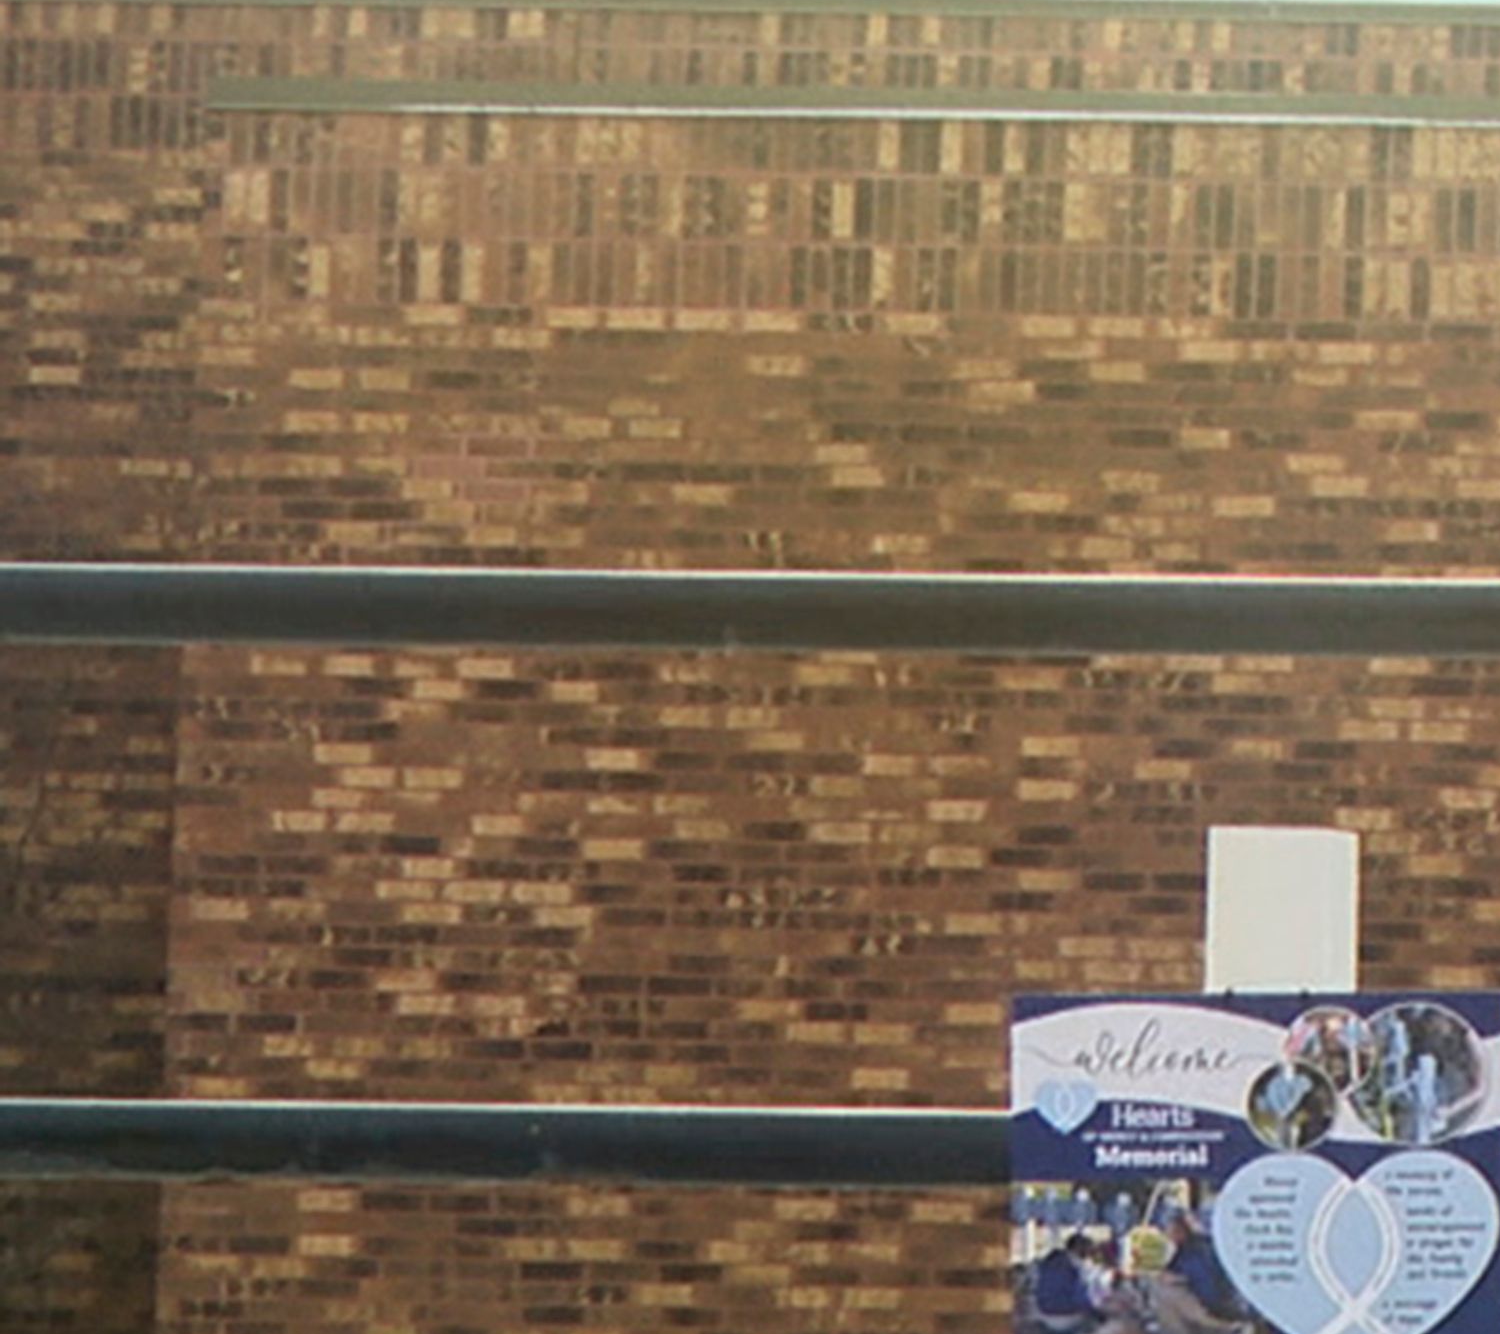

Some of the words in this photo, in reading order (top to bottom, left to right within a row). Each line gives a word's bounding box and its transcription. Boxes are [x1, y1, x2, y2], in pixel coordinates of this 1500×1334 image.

[1060, 1018, 1240, 1079] welcome
[1111, 1103, 1194, 1130] Hearts
[1095, 1143, 1209, 1169] Memorial
